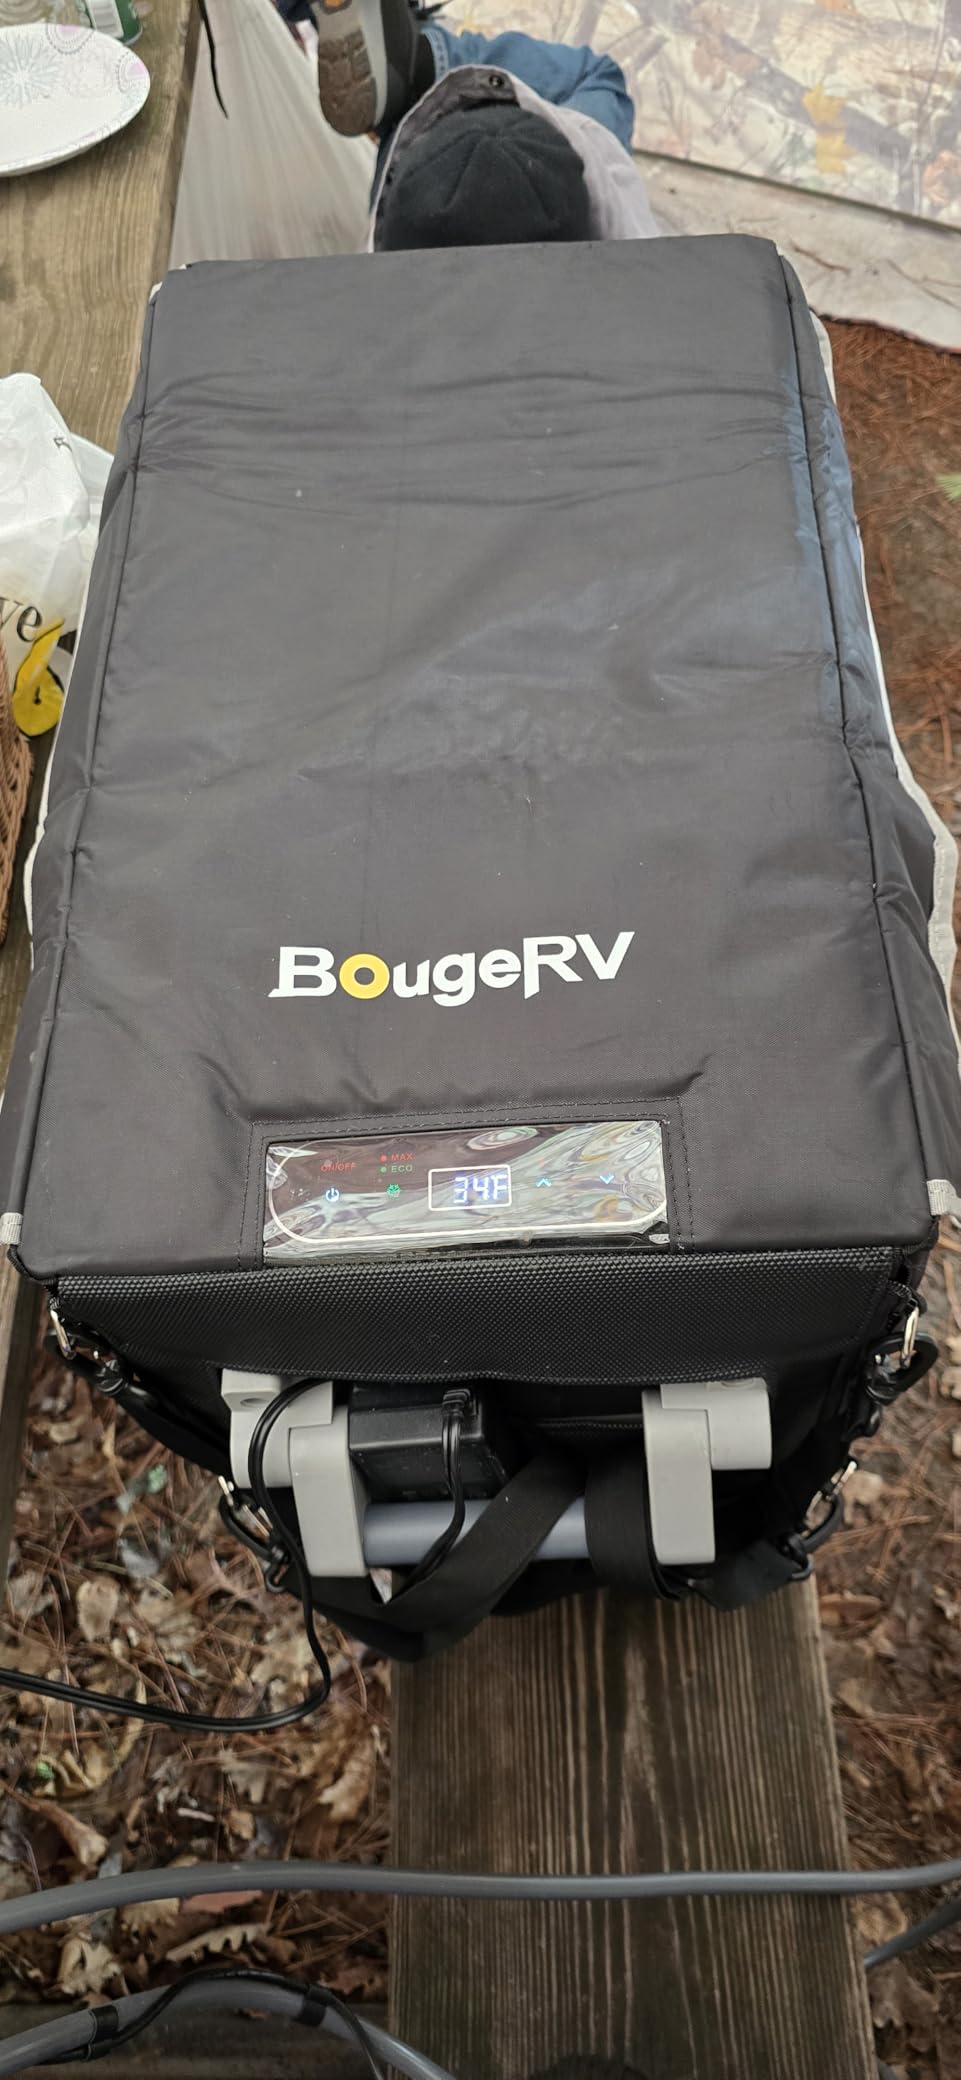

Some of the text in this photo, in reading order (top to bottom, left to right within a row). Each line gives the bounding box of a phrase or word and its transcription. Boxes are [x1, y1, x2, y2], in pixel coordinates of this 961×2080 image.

[267, 931, 635, 1007] BougeRV
[391, 1152, 413, 1162] MAX
[320, 1161, 357, 1172] ON/OFF
[391, 1164, 413, 1173] ECO
[453, 1174, 508, 1204] 34F
